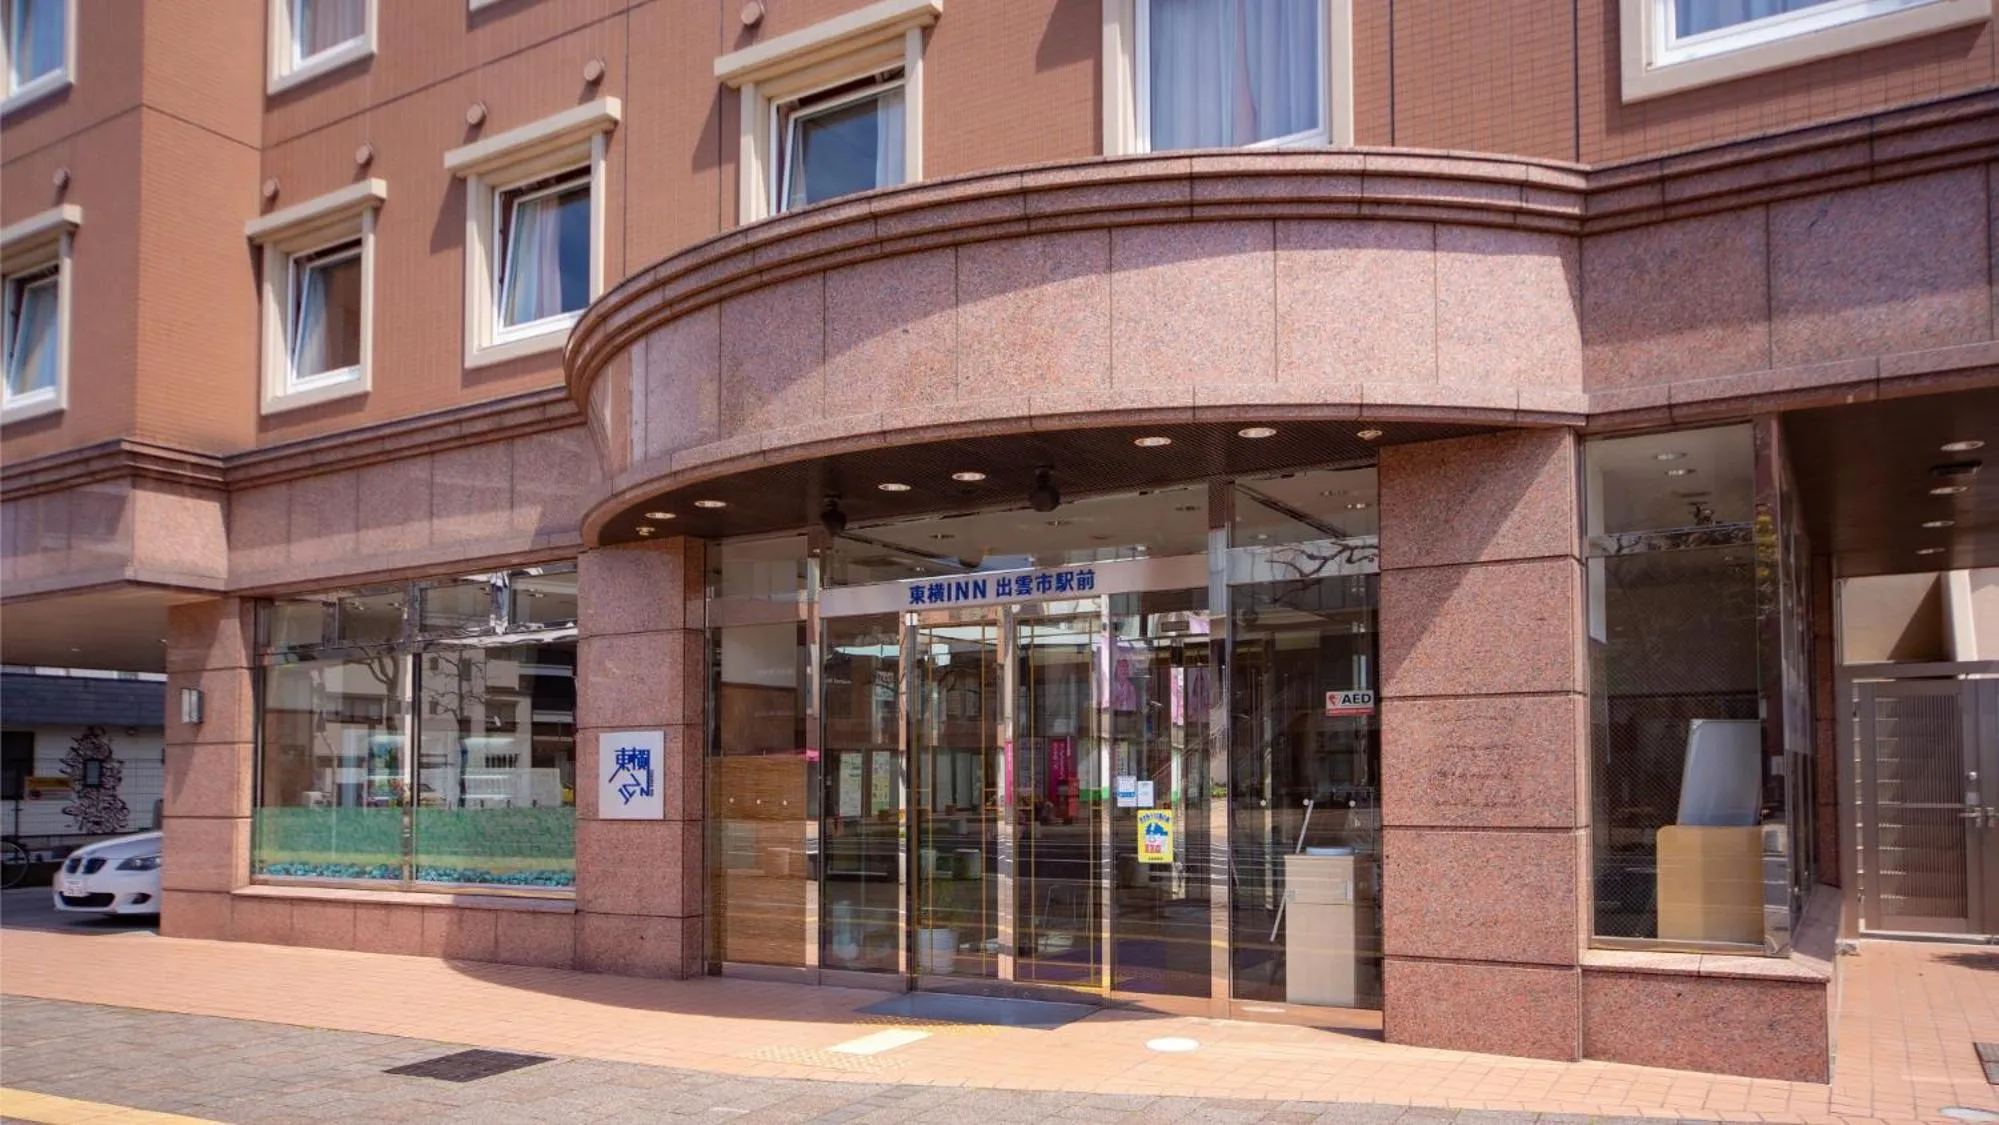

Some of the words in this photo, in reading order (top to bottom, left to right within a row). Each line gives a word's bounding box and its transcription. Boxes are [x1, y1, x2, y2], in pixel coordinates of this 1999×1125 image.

[909, 579, 987, 605] 東横INN
[996, 569, 1095, 598] 出雲市駅前
[1341, 693, 1371, 704] AED
